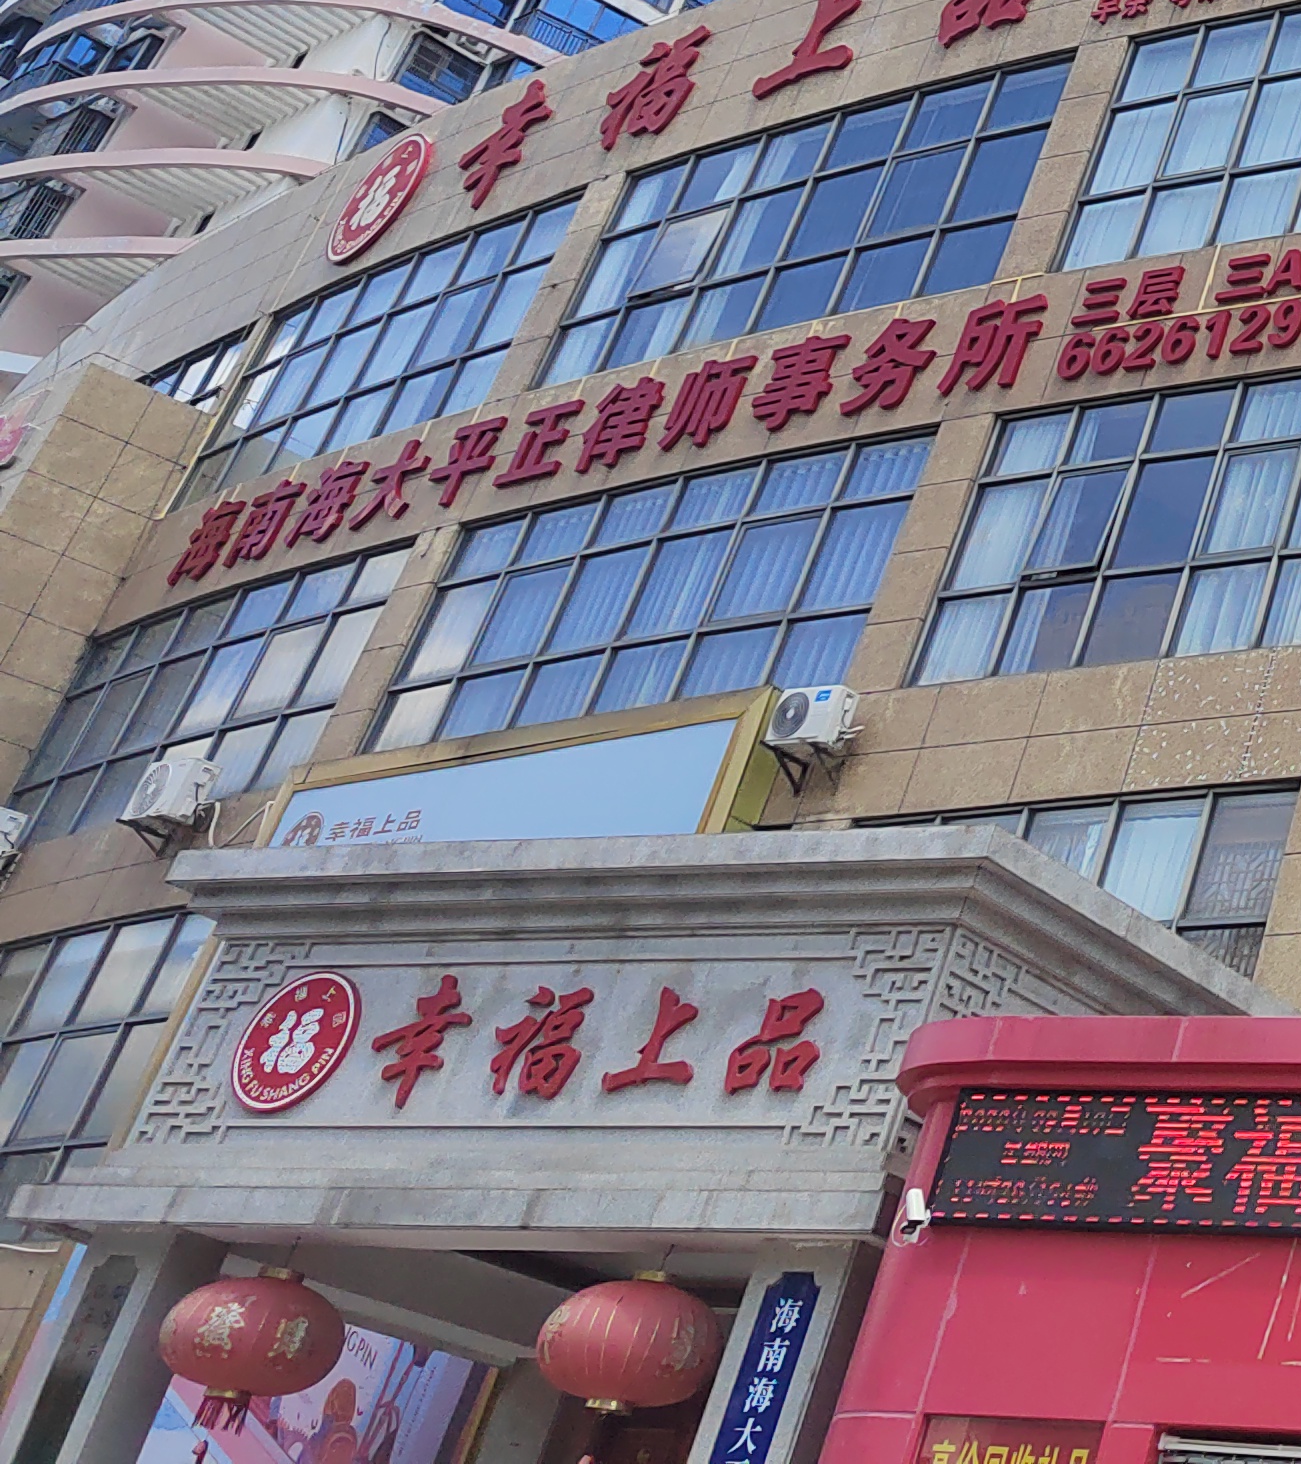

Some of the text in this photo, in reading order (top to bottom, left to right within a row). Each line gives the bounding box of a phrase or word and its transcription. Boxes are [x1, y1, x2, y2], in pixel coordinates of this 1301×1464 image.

[1071, 265, 1185, 326] 三层
[166, 293, 1049, 586] 海南海大平正律师事务所
[325, 809, 422, 841] 幸福上品
[260, 1008, 325, 1074] 福
[371, 974, 824, 1108] 幸福上品
[726, 1298, 803, 1464] 海南海大
